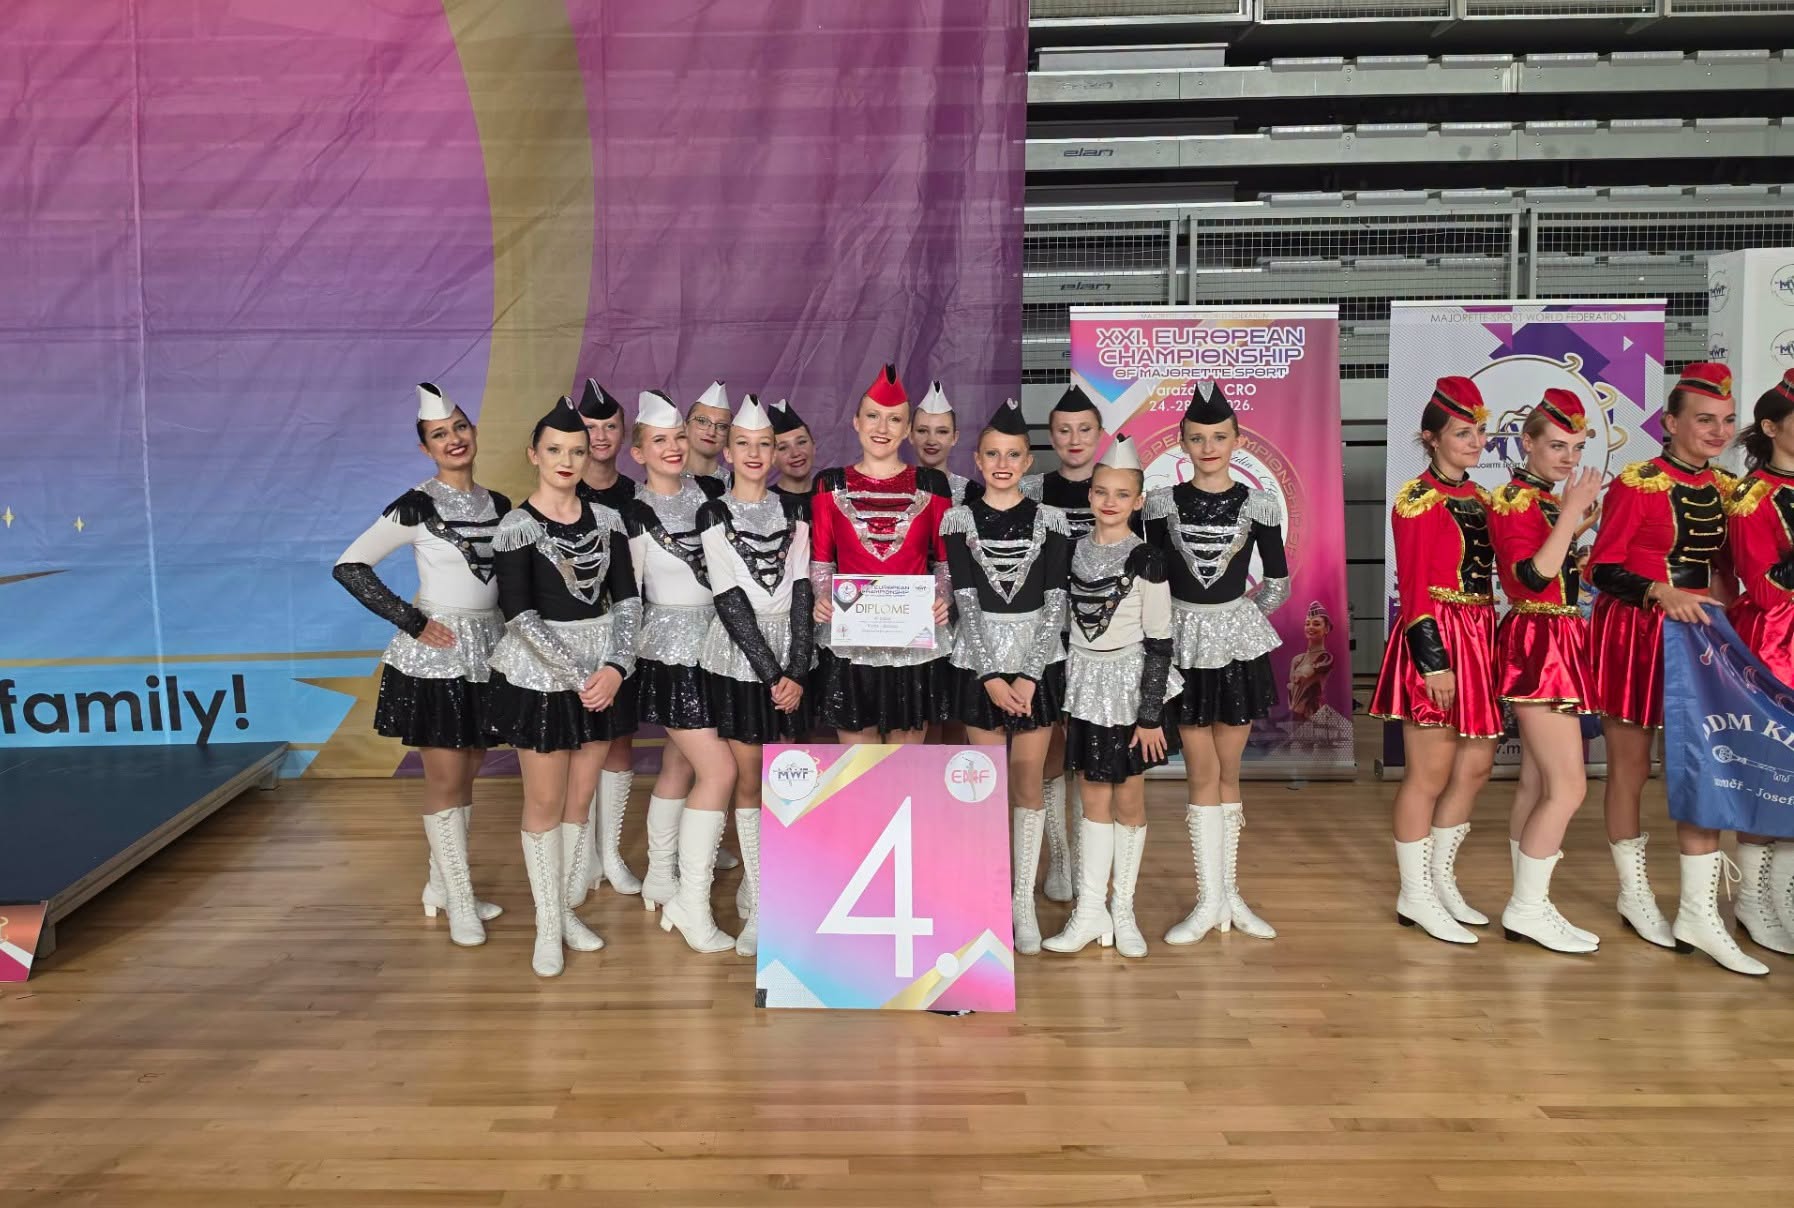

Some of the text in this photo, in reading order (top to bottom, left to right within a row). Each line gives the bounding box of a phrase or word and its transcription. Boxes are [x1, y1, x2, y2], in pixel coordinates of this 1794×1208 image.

[1063, 147, 1114, 157] elan
[1060, 281, 1111, 291] elan
[1527, 313, 1563, 322] WORLD
[1567, 312, 1626, 322] FEDERATION
[1097, 327, 1305, 347] XXI. EUROPEAN
[1100, 347, 1303, 366] CHAMPIONSHIP
[1114, 366, 1289, 379] OF MAJORETTE SPORT
[1147, 382, 1256, 396] Varažd CRO
[1149, 400, 1254, 411] 24.-28 026.
[856, 603, 910, 615] DIPLOME
[0, 674, 249, 744] family!
[778, 768, 809, 780] MWF
[1756, 787, 1794, 805] Josef
[816, 795, 960, 978] 4.
